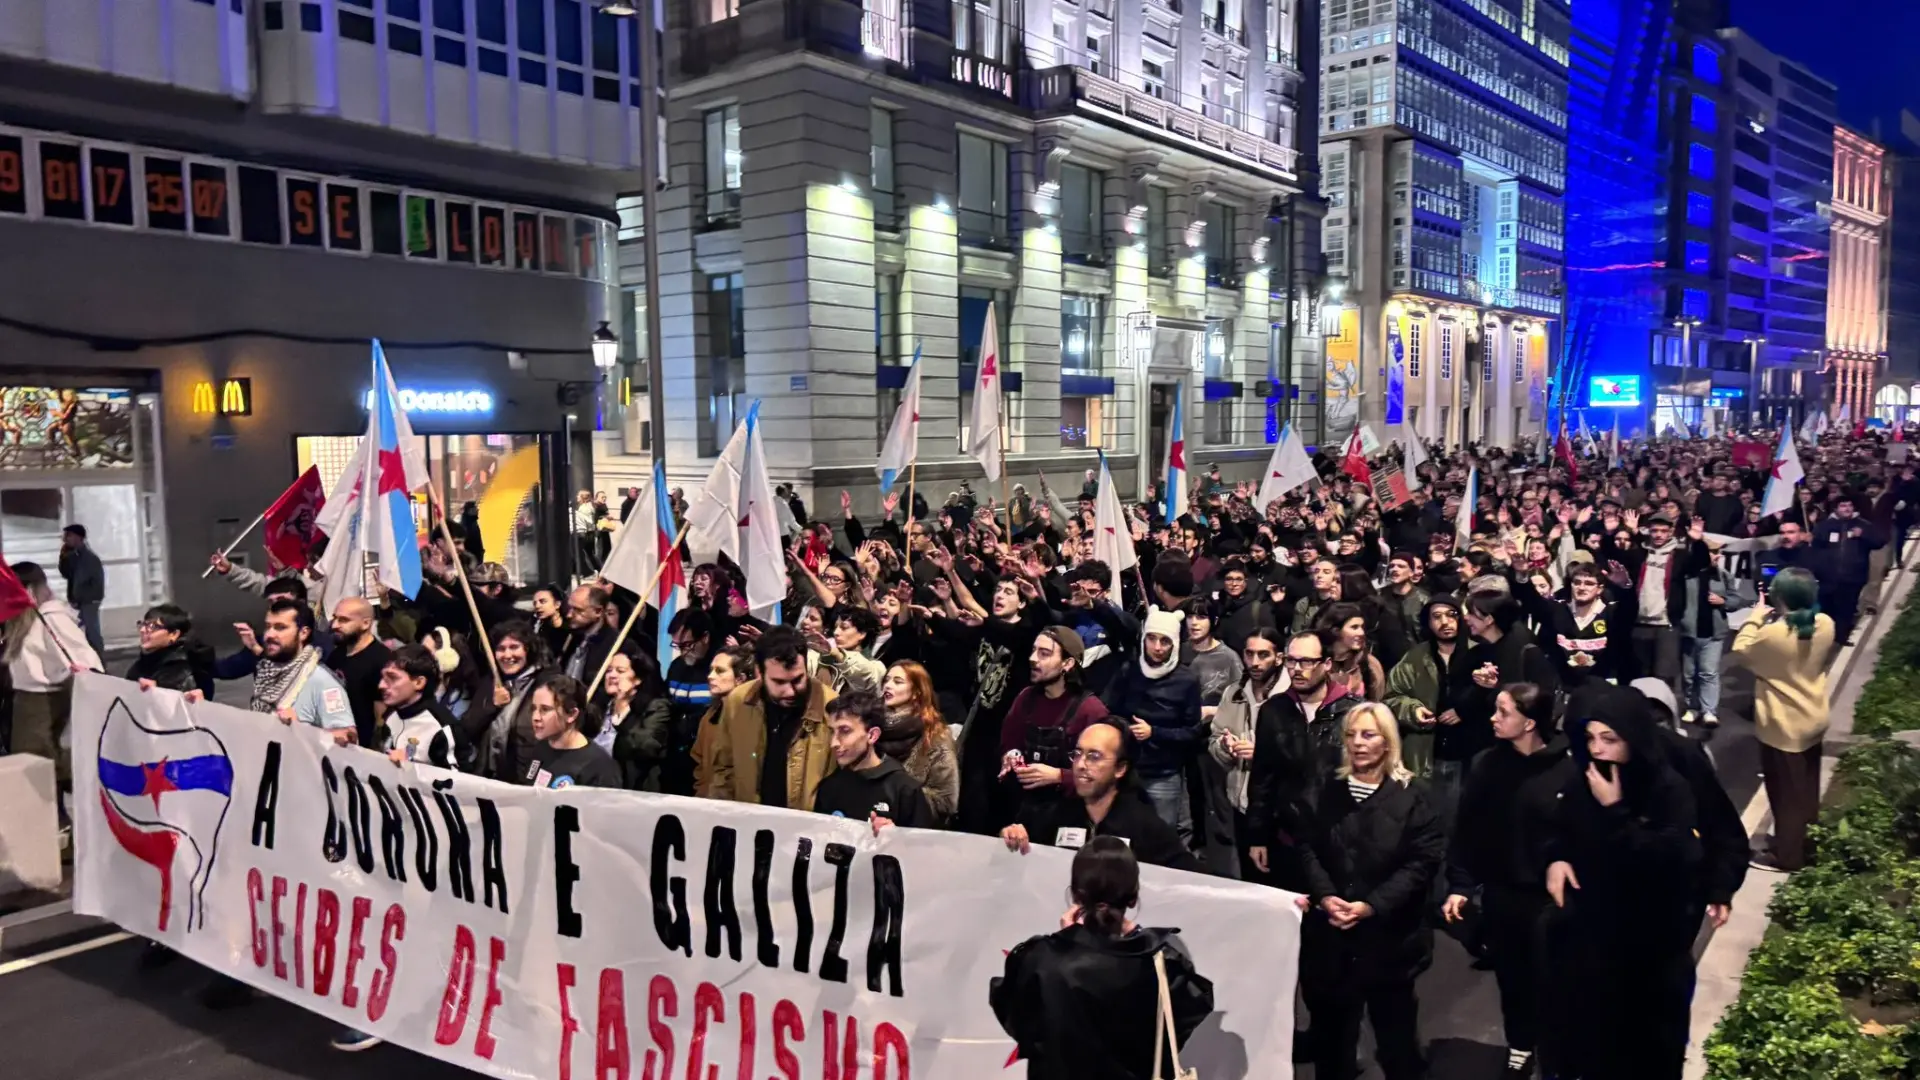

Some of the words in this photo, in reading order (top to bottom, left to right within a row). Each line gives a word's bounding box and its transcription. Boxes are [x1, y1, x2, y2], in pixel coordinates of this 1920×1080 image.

[95, 166, 125, 206] 17
[146, 173, 183, 214] 35
[247, 867, 406, 1022] CEIBES
[434, 924, 506, 1060] DE
[251, 741, 281, 850] A
[322, 755, 510, 915] CORUÑA
[554, 804, 582, 938] E
[650, 813, 906, 997] GALIZA
